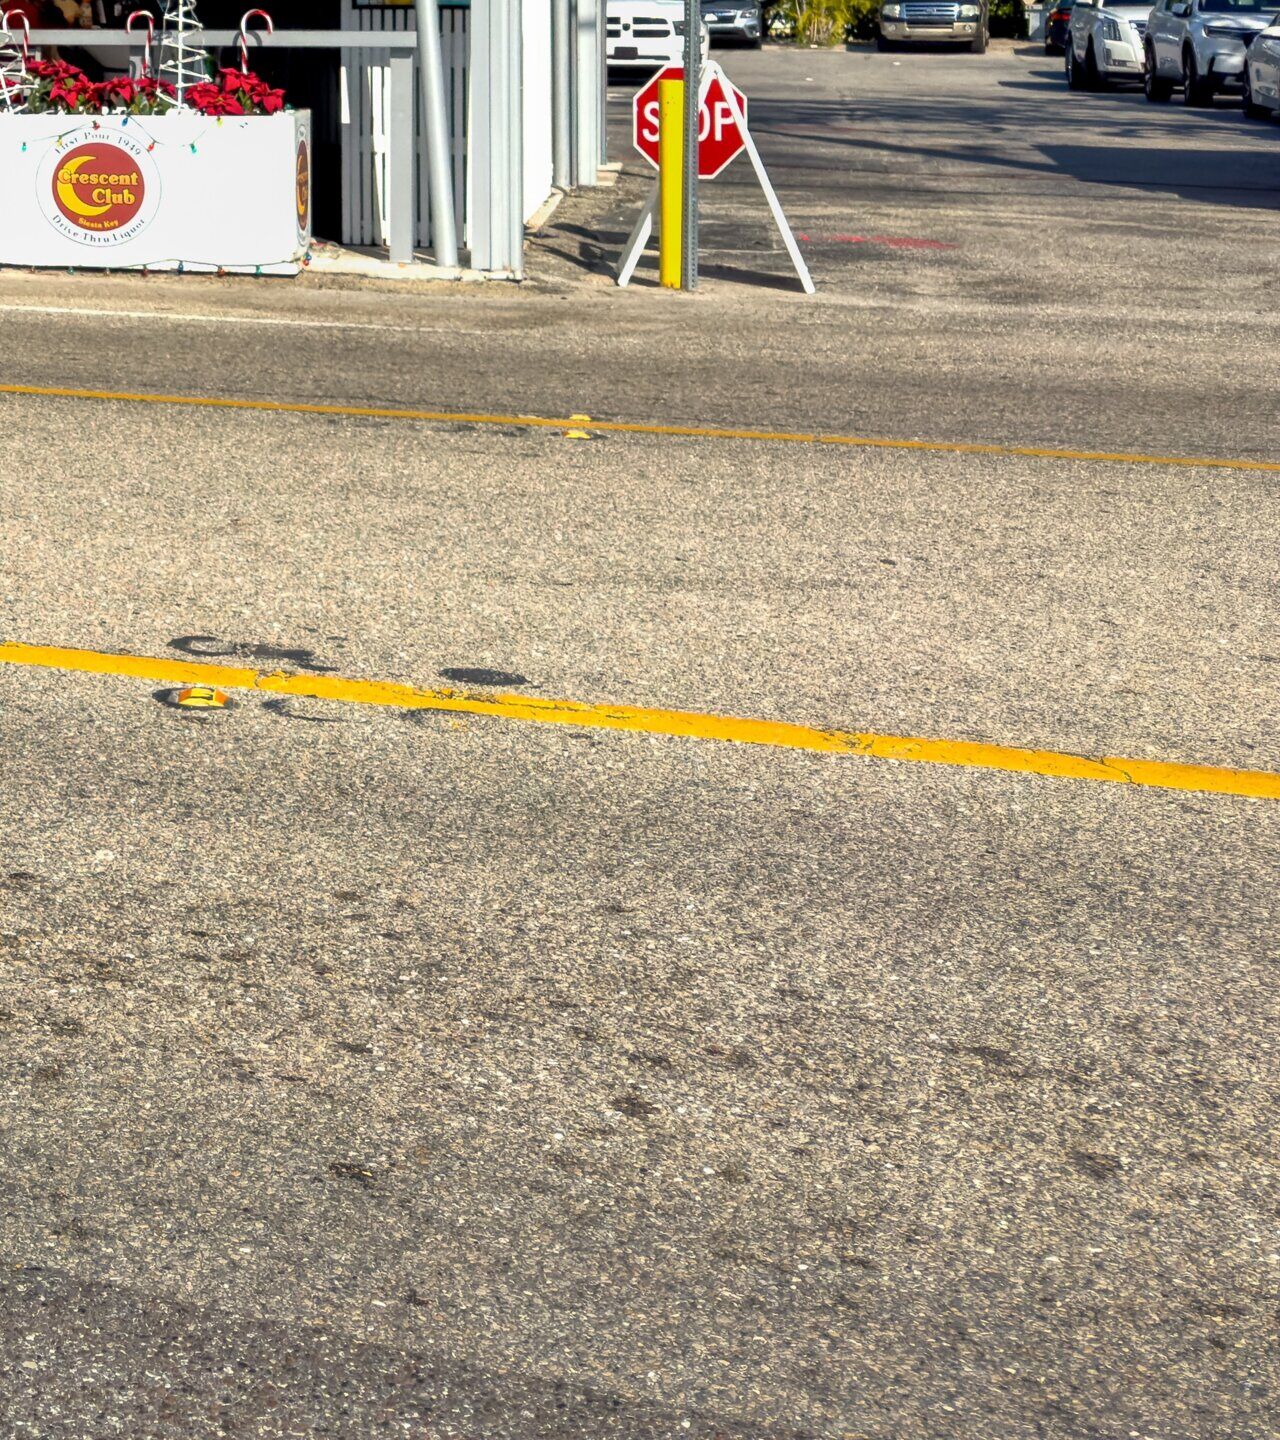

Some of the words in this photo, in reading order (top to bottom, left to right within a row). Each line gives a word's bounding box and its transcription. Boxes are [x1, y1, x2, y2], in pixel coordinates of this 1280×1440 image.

[642, 100, 734, 143] SOP
[118, 137, 142, 155] 1949
[57, 168, 139, 186] Crescent
[92, 188, 136, 205] Club
[103, 219, 119, 228] Key
[112, 219, 145, 241] Liquor
